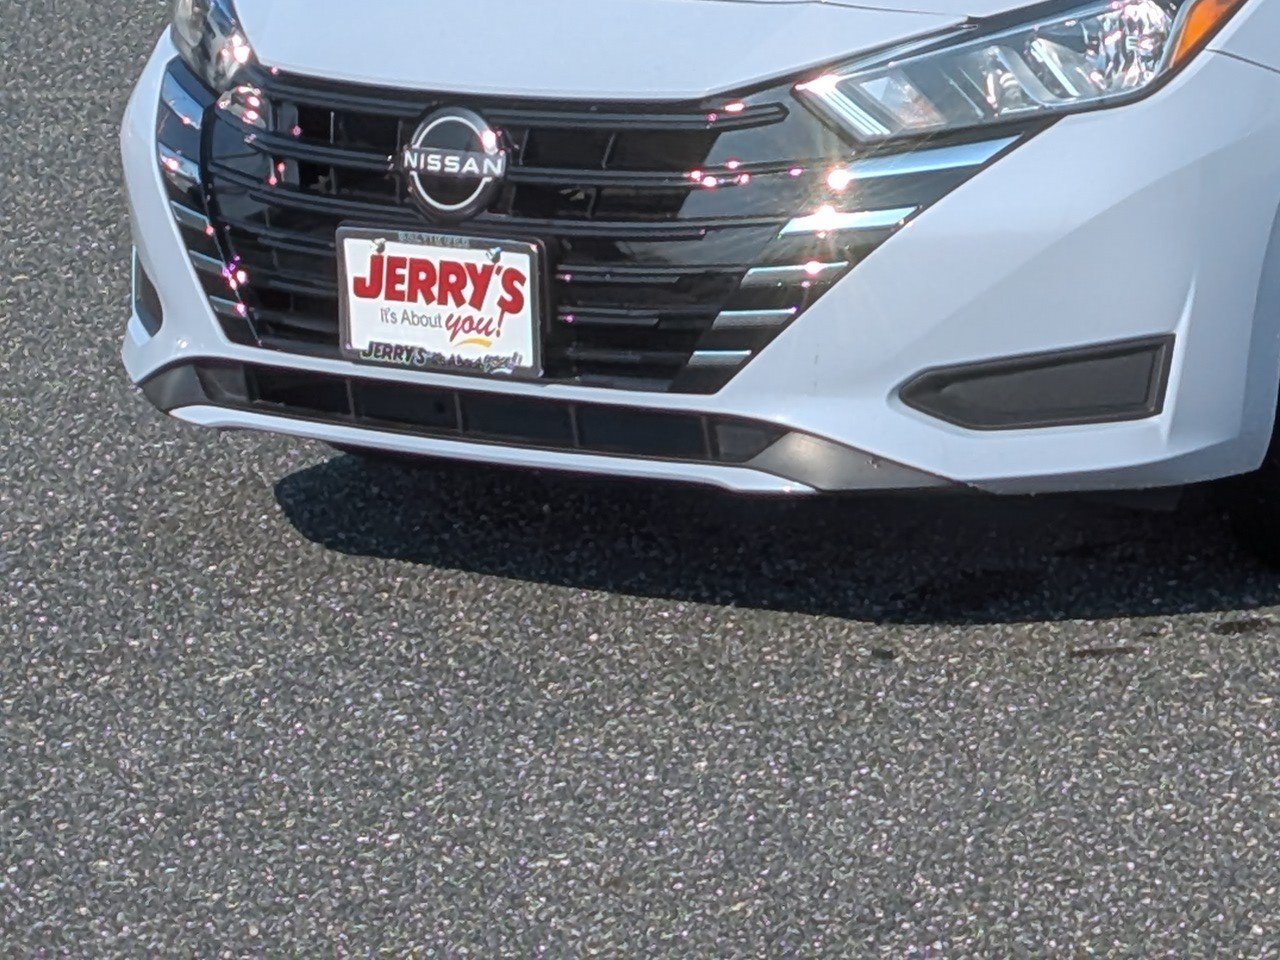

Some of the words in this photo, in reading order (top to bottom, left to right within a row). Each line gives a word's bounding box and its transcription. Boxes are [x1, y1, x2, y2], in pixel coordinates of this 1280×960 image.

[403, 149, 504, 176] NISSAN
[353, 254, 526, 315] JERRY'S
[380, 307, 397, 325] It's
[401, 311, 442, 329] About
[444, 309, 505, 343] you!
